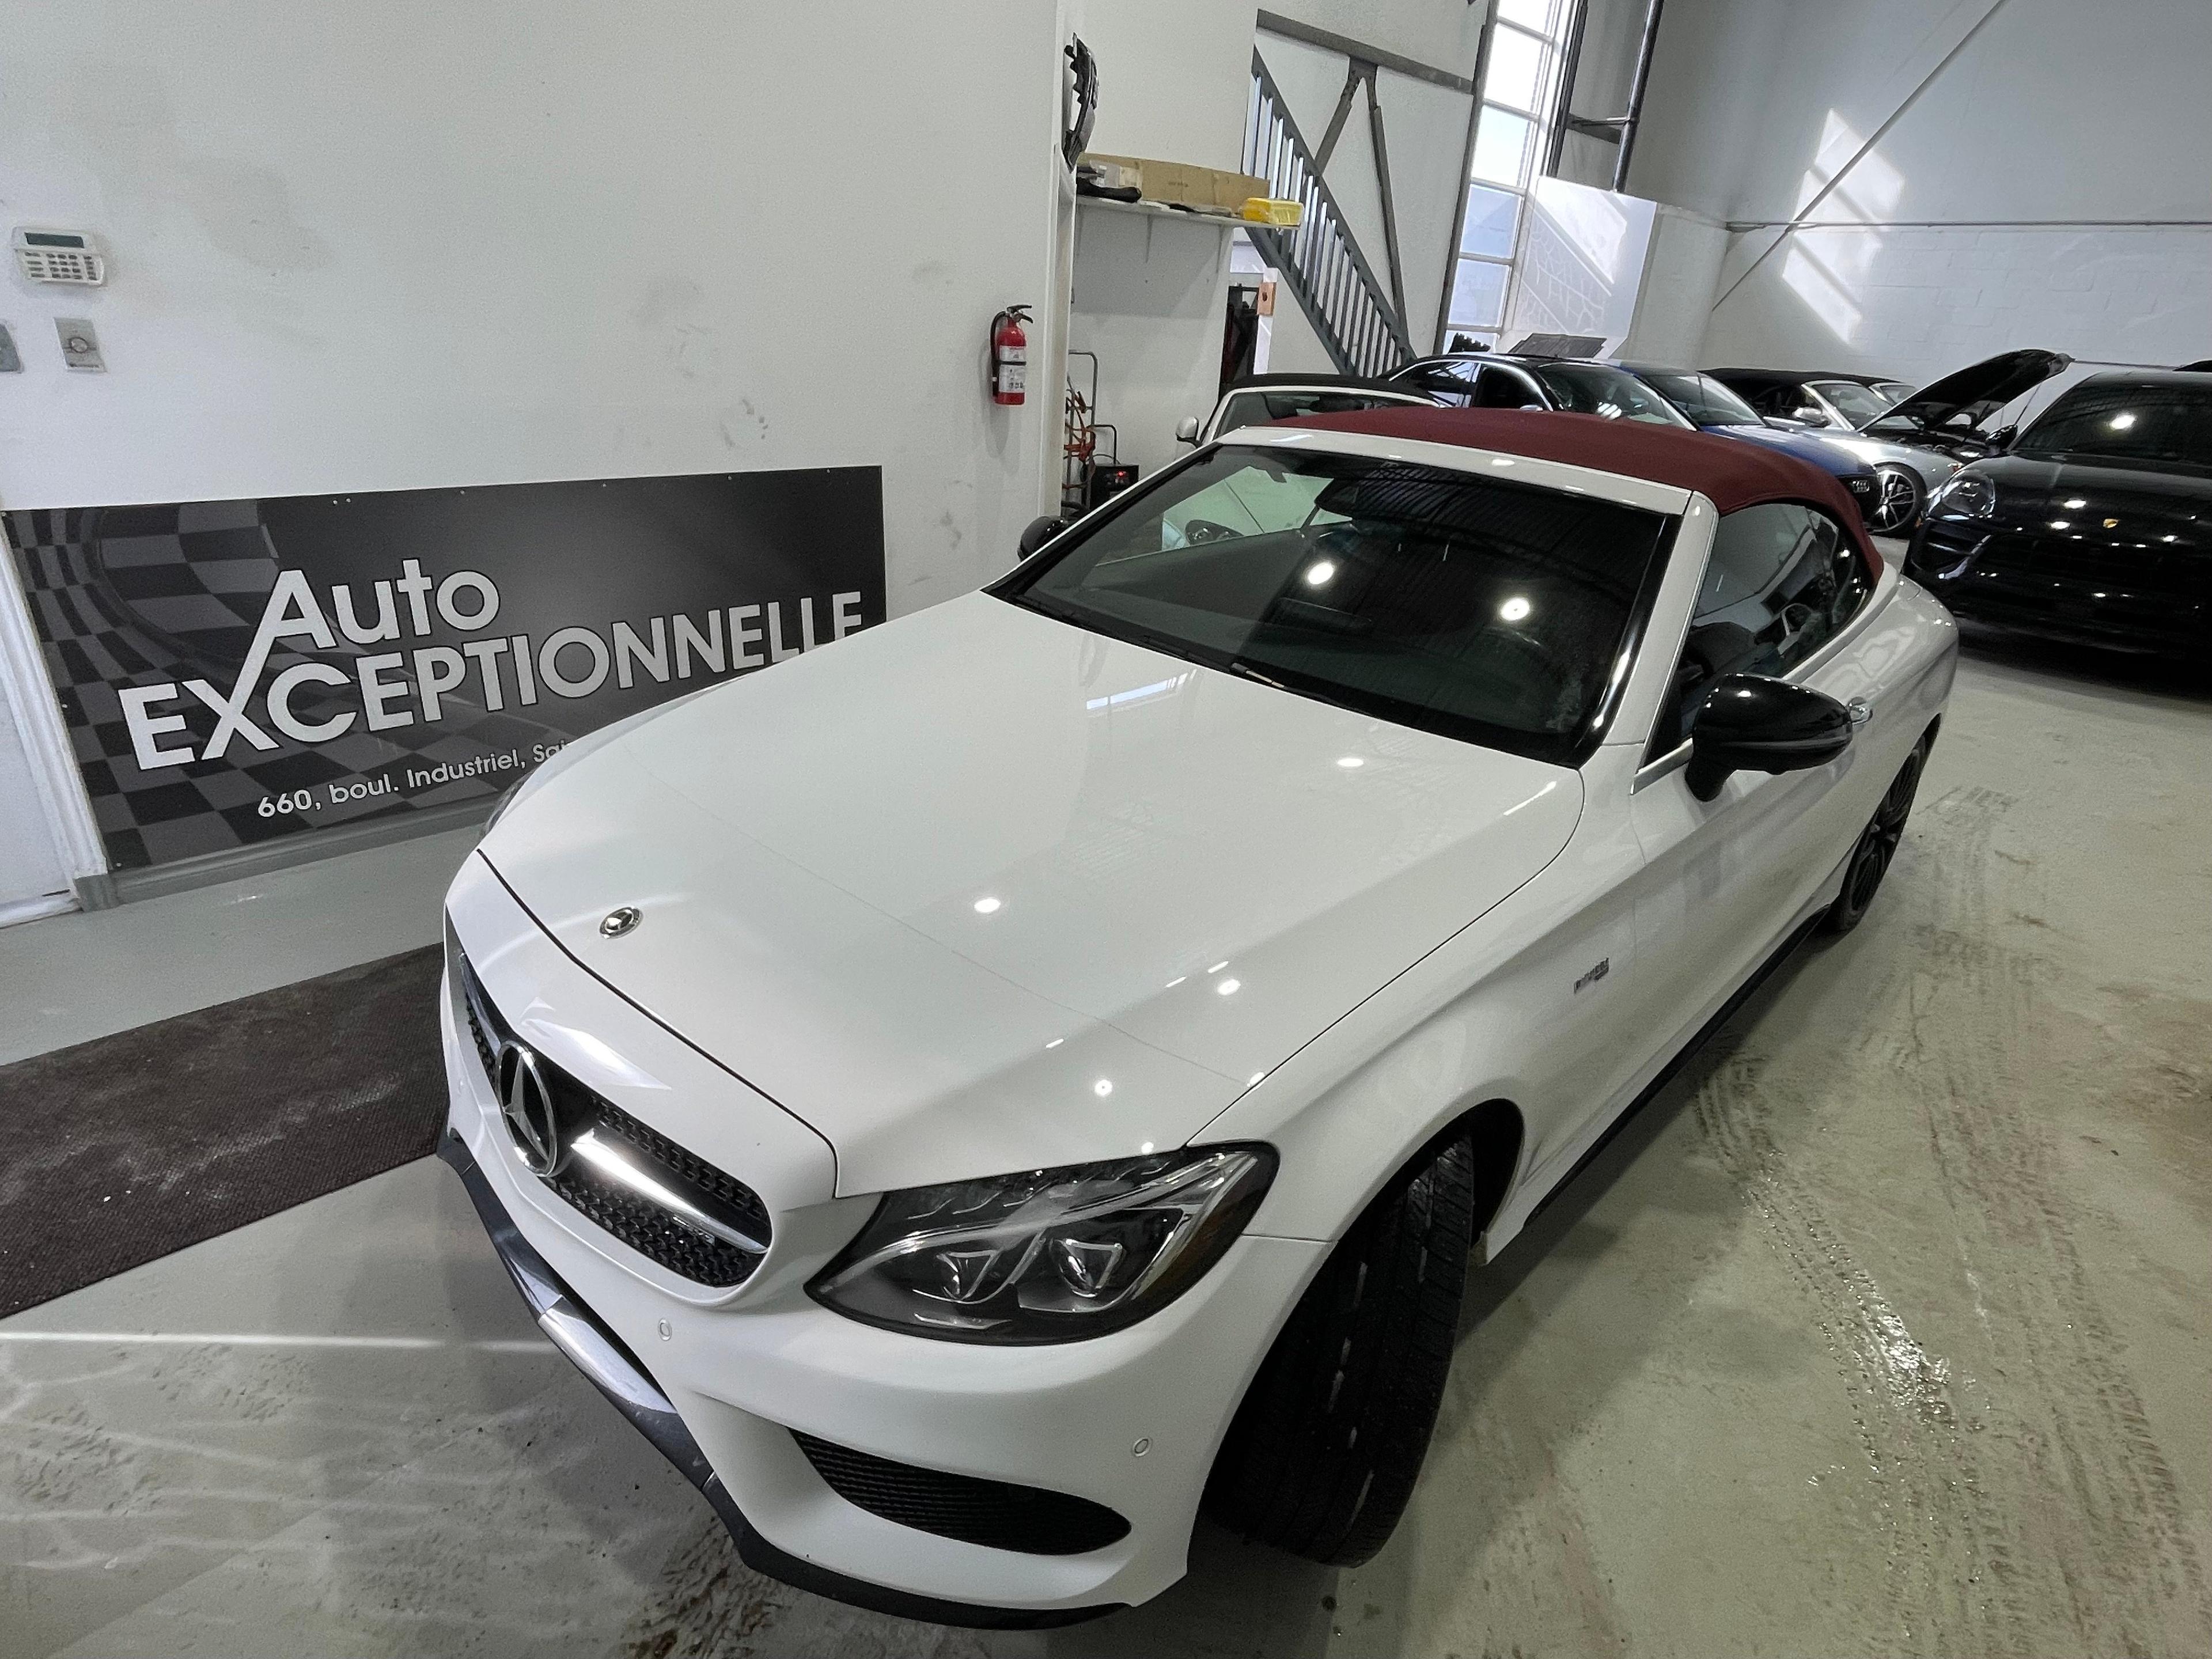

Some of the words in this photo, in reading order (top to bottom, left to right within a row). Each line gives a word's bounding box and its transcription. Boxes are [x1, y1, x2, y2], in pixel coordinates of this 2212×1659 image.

[247, 558, 500, 650] Auto
[117, 591, 862, 771] EXCEPTIONNELLE
[257, 790, 321, 817] 660,
[328, 774, 399, 804] boul.
[406, 749, 526, 789] Industriel,
